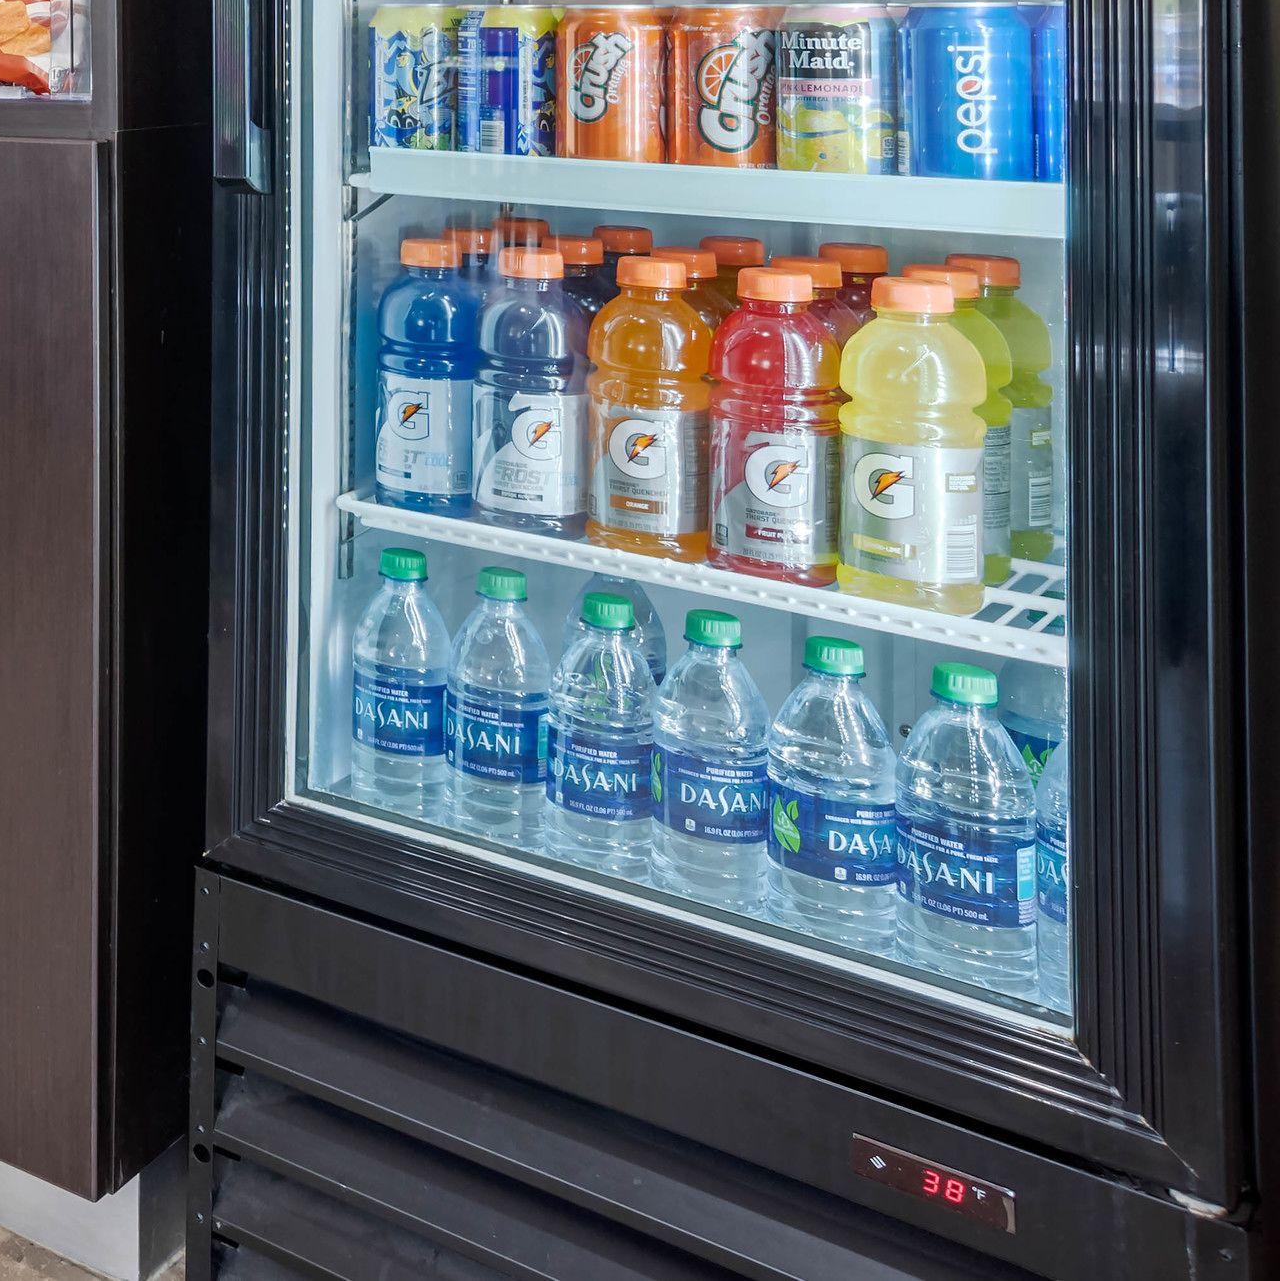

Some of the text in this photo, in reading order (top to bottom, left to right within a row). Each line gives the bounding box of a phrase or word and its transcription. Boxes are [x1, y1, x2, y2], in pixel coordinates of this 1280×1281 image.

[781, 30, 862, 50] Minute
[698, 27, 776, 154] Crush
[801, 83, 864, 94] LEMONADE
[946, 41, 999, 155] pepsi
[388, 391, 429, 440] G
[512, 407, 562, 461] G
[608, 418, 667, 481] G
[745, 444, 810, 508] G
[854, 453, 915, 519] G
[625, 501, 650, 510] ORANGE
[745, 513, 770, 522] THIRST
[355, 696, 428, 730] DASANI
[481, 709, 500, 720] WATER
[447, 717, 520, 755] DASANI
[571, 743, 618, 758] PURIFIED WATER
[554, 757, 637, 793] DASANI
[706, 766, 753, 778] PURIFIED WATER
[681, 782, 766, 817] DASANI
[704, 826, 716, 835] 16.9
[828, 828, 892, 861] DASA
[911, 827, 964, 850] PURIFIED WATER
[855, 872, 867, 882] 16.9
[896, 841, 994, 895] DASANI
[928, 898, 937, 908] OZ
[937, 901, 952, 913] (1.06
[964, 907, 979, 919] 500
[978, 912, 989, 921] mL
[922, 1170, 987, 1204] 38 °F
